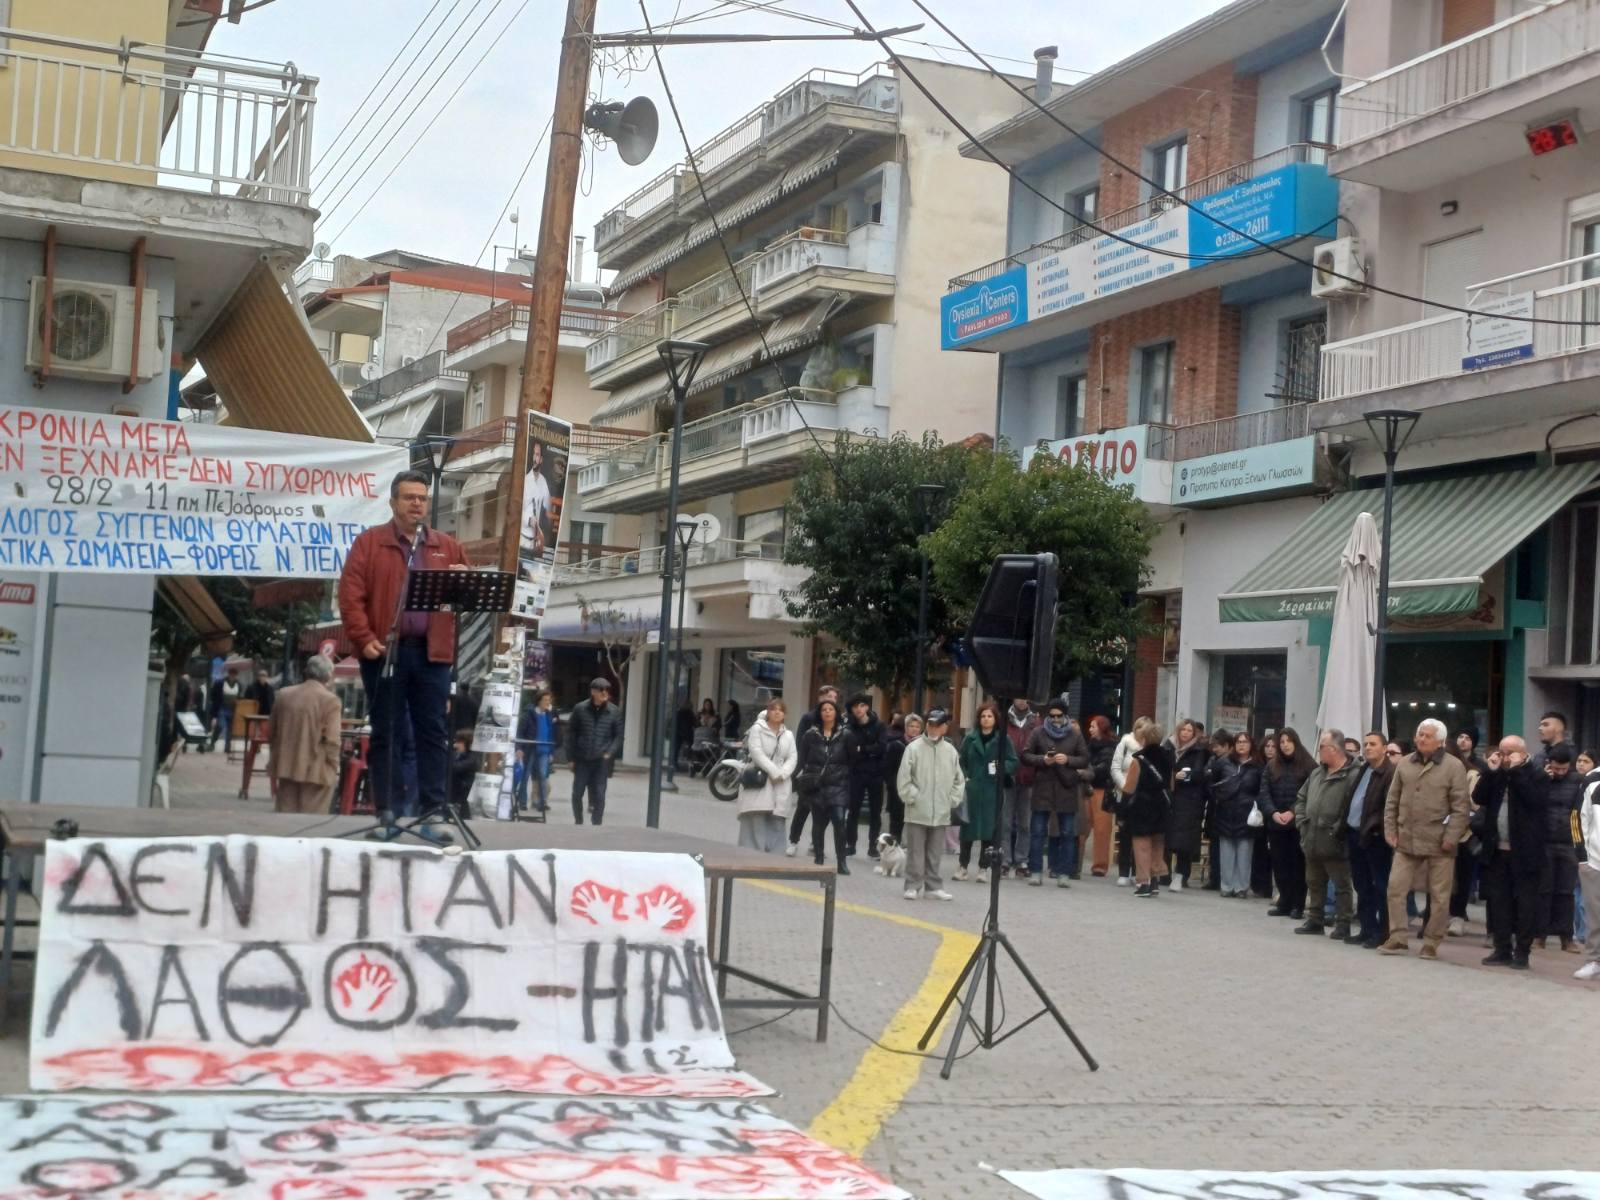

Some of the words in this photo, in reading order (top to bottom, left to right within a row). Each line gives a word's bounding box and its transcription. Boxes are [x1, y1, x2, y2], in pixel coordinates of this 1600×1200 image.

[1247, 215, 1269, 236] 26111
[952, 302, 979, 323] Dyslexia
[988, 289, 1016, 310] Centers
[121, 421, 191, 456] ΜΕΤΑ
[0, 442, 24, 472] Ν
[245, 461, 379, 499] ΣΥΓΧΩΡΟΥΜΕ
[1058, 439, 1137, 481] ΟΤΥΠΟ
[47, 475, 113, 504] 28/2
[145, 482, 168, 509] 11
[206, 488, 304, 523] Πεζόδρομος
[1, 508, 78, 536] ΛΟΓΟΣ
[96, 511, 215, 542] ΣΥΓΓΕΝΩΝ
[227, 518, 333, 545] ΘΥΜΑΤΩΝ
[276, 547, 294, 572] Ν.
[57, 843, 258, 928] ΔΕΝ
[316, 846, 558, 940] ΗΤΑΝ
[44, 938, 520, 1048] ΛΑΘΟΣ
